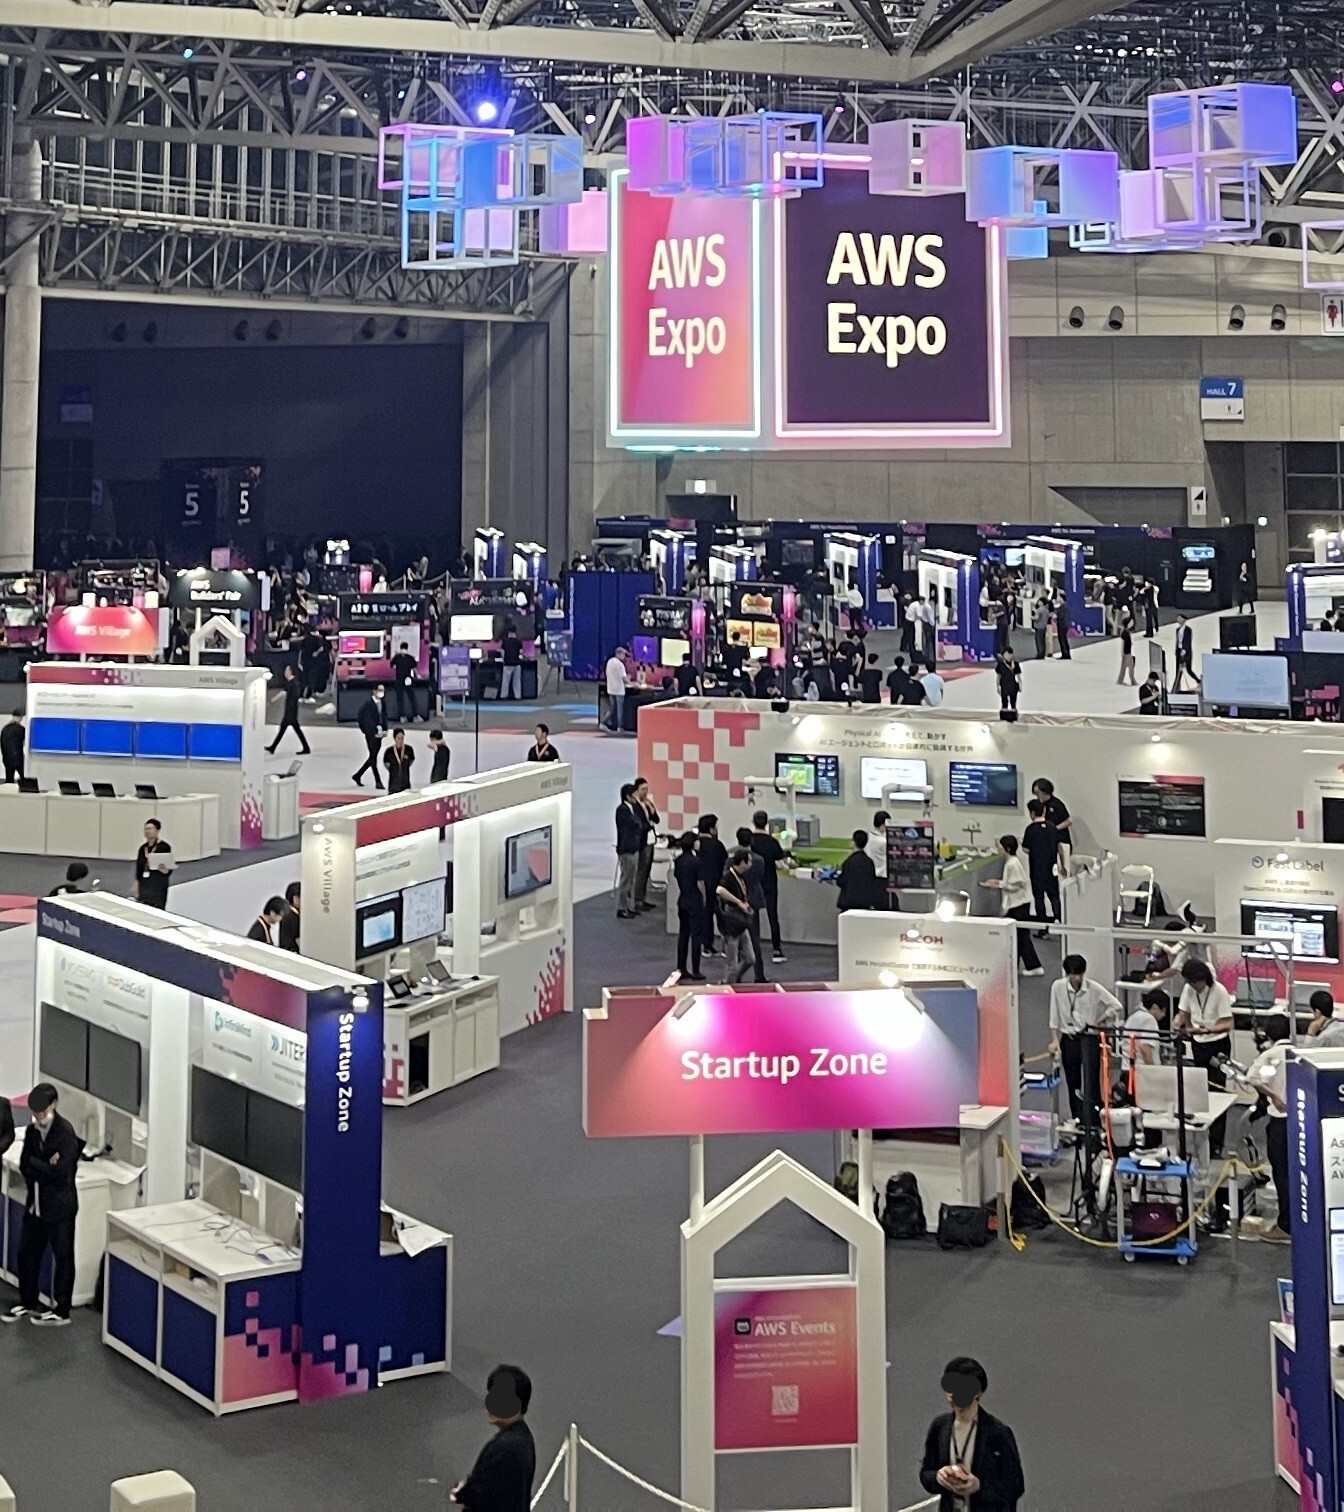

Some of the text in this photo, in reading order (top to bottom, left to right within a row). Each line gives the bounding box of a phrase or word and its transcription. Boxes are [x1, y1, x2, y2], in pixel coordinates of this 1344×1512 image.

[648, 234, 726, 290] AWS
[826, 232, 946, 289] AWS
[648, 307, 726, 368] Expo
[826, 302, 947, 369] Expo
[1206, 382, 1237, 396] HALL 7
[184, 492, 199, 516] 5
[239, 490, 249, 515] 5
[322, 837, 333, 914] AWS Village
[336, 1013, 355, 1132] Startup Zone
[681, 1048, 888, 1085] Startup Zone
[1296, 1088, 1309, 1224] Startup Zone
[754, 1320, 837, 1337] AWS Events
